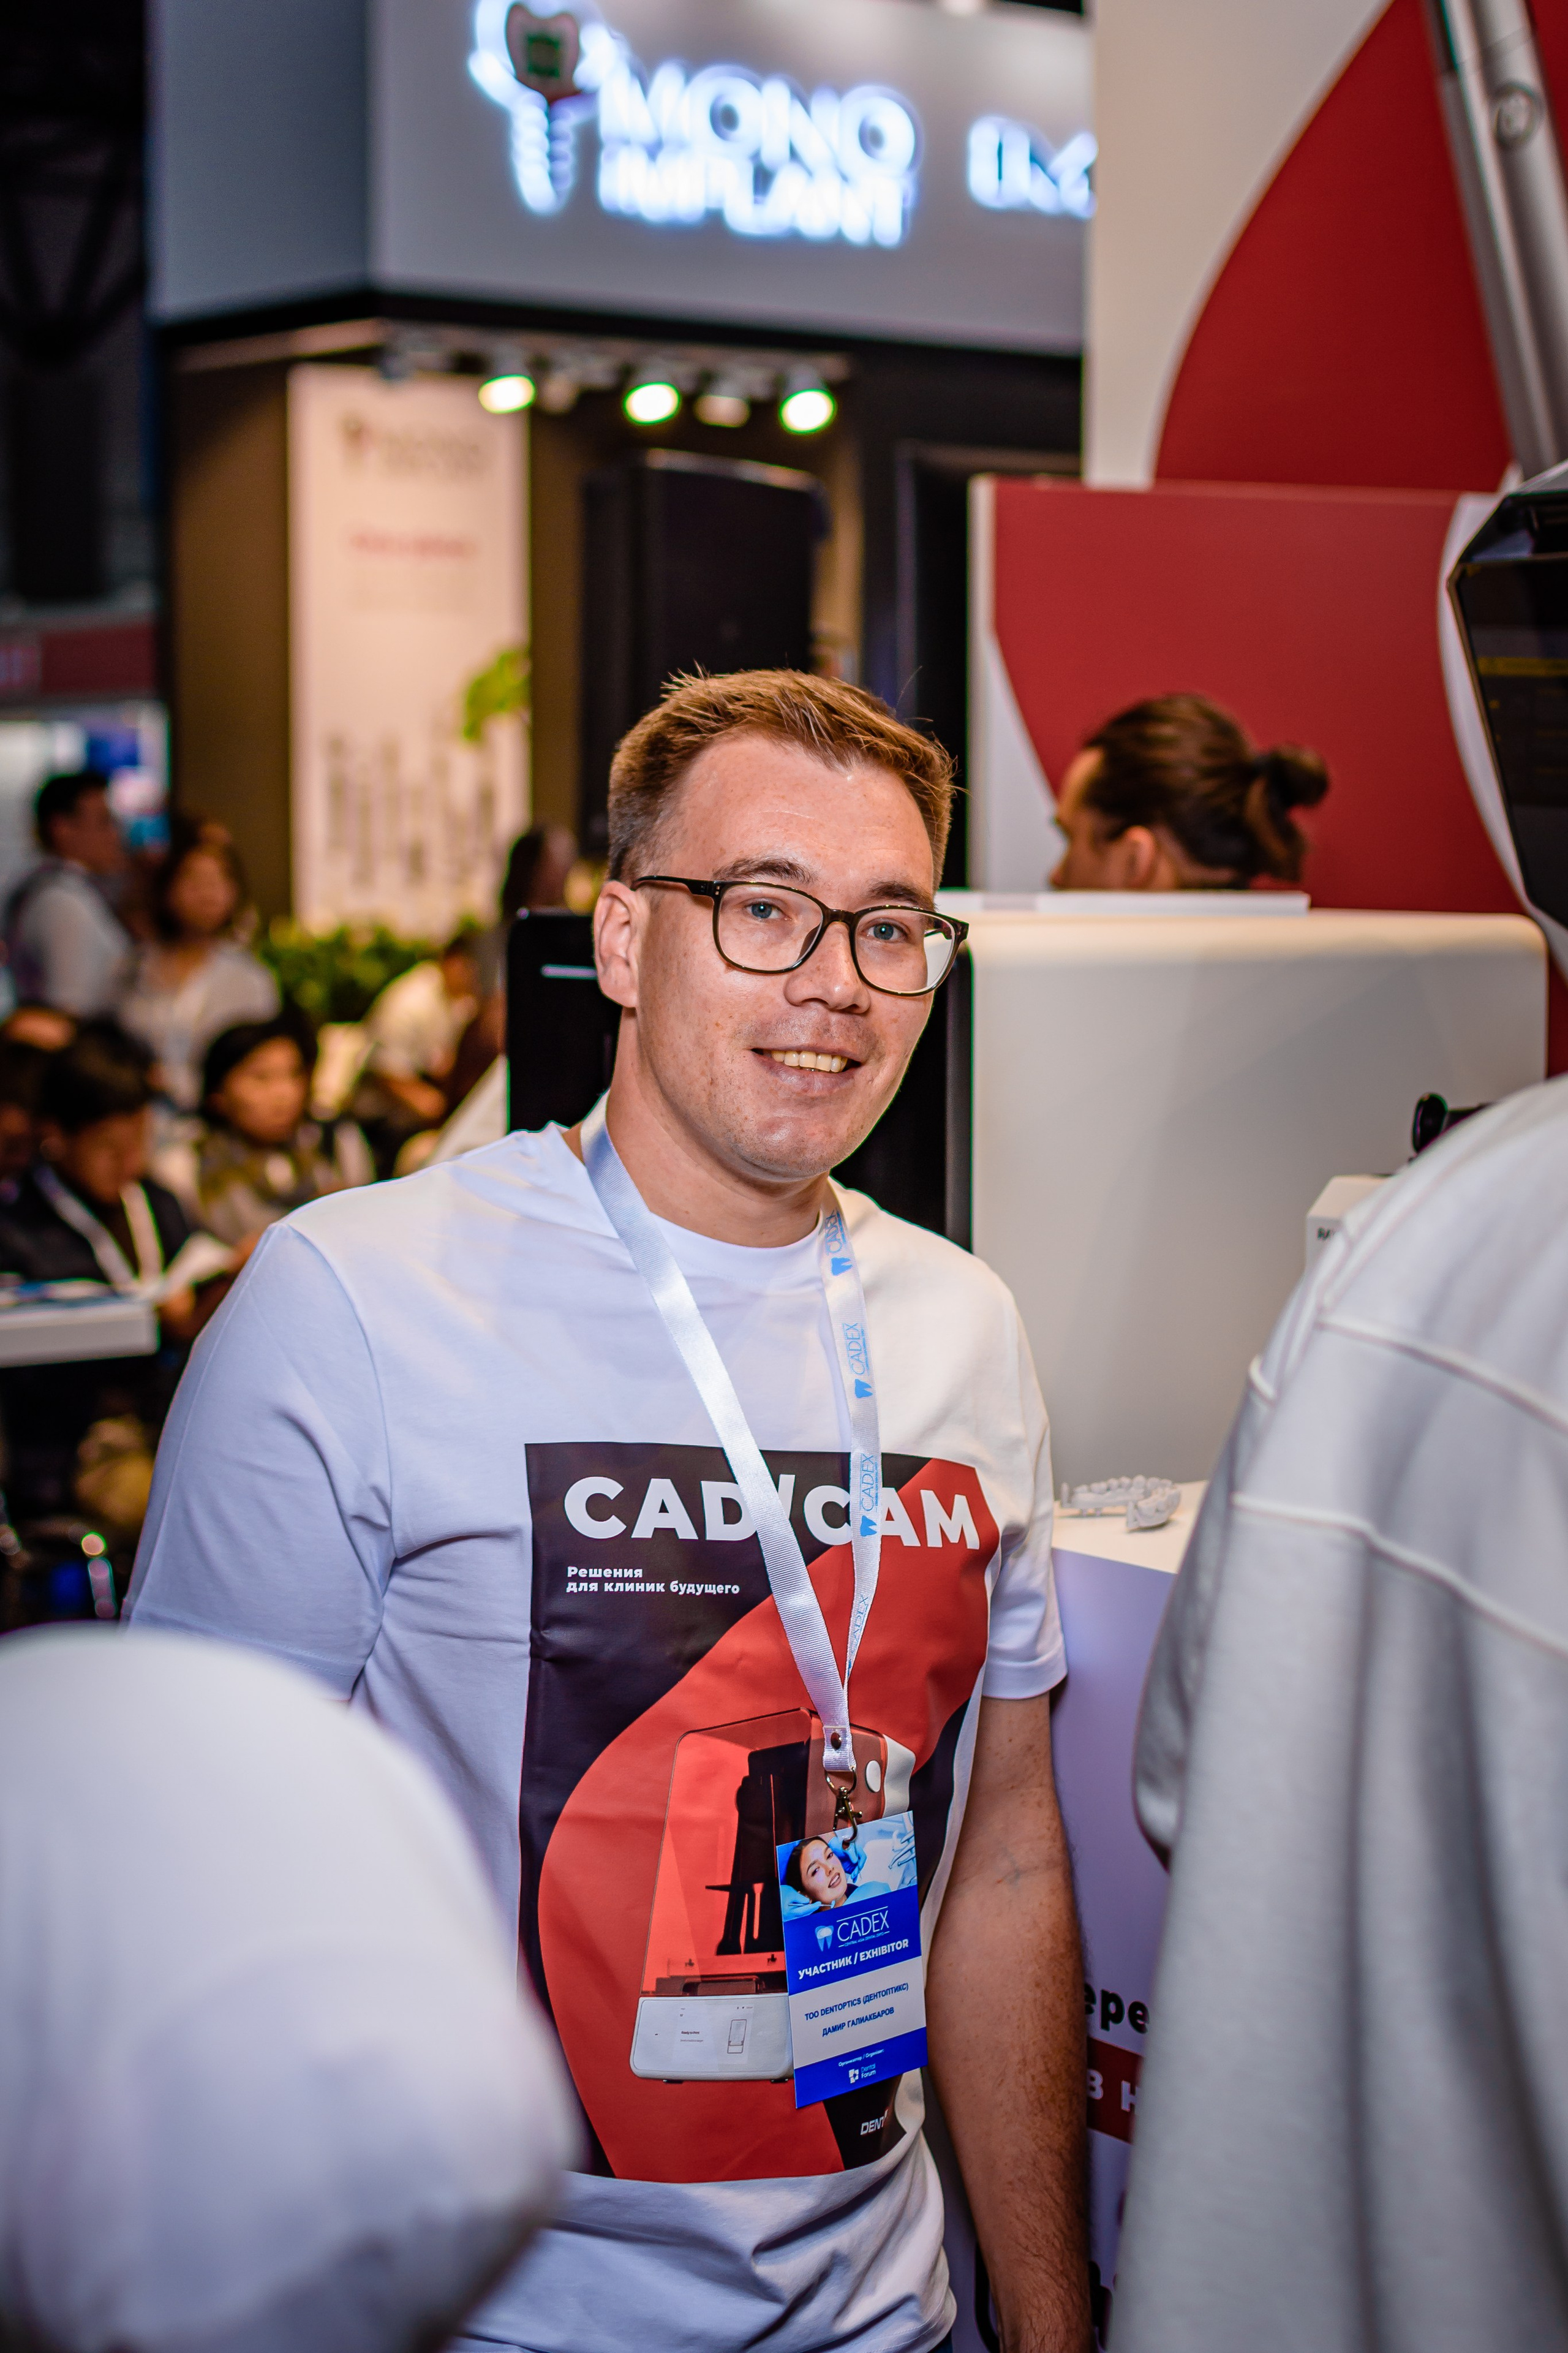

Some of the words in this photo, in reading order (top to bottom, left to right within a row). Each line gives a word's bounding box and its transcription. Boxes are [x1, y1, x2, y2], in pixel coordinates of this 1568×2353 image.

[600, 63, 917, 183] MONO
[845, 1322, 865, 1375] CADEX
[861, 1453, 874, 1512] CADEX
[564, 1473, 980, 1550] CAD/CAM
[566, 1582, 598, 1593] для
[603, 1582, 666, 1593] клиник
[669, 1580, 741, 1596] будущего
[567, 1565, 643, 1578] Решения
[837, 1910, 889, 1941] CADEX
[798, 1955, 852, 1980] УЧАСТНИК
[853, 1952, 858, 1965] /
[859, 1939, 909, 1962] EXHIBITOR
[805, 2011, 819, 2020] ТОО
[820, 1998, 861, 2016] DENTOPTICS
[862, 1982, 909, 2004] (ДЕНТОПТИКС)
[822, 2023, 846, 2037] ДАМИР
[847, 2007, 894, 2028] ГАЛИАКБАРОВ
